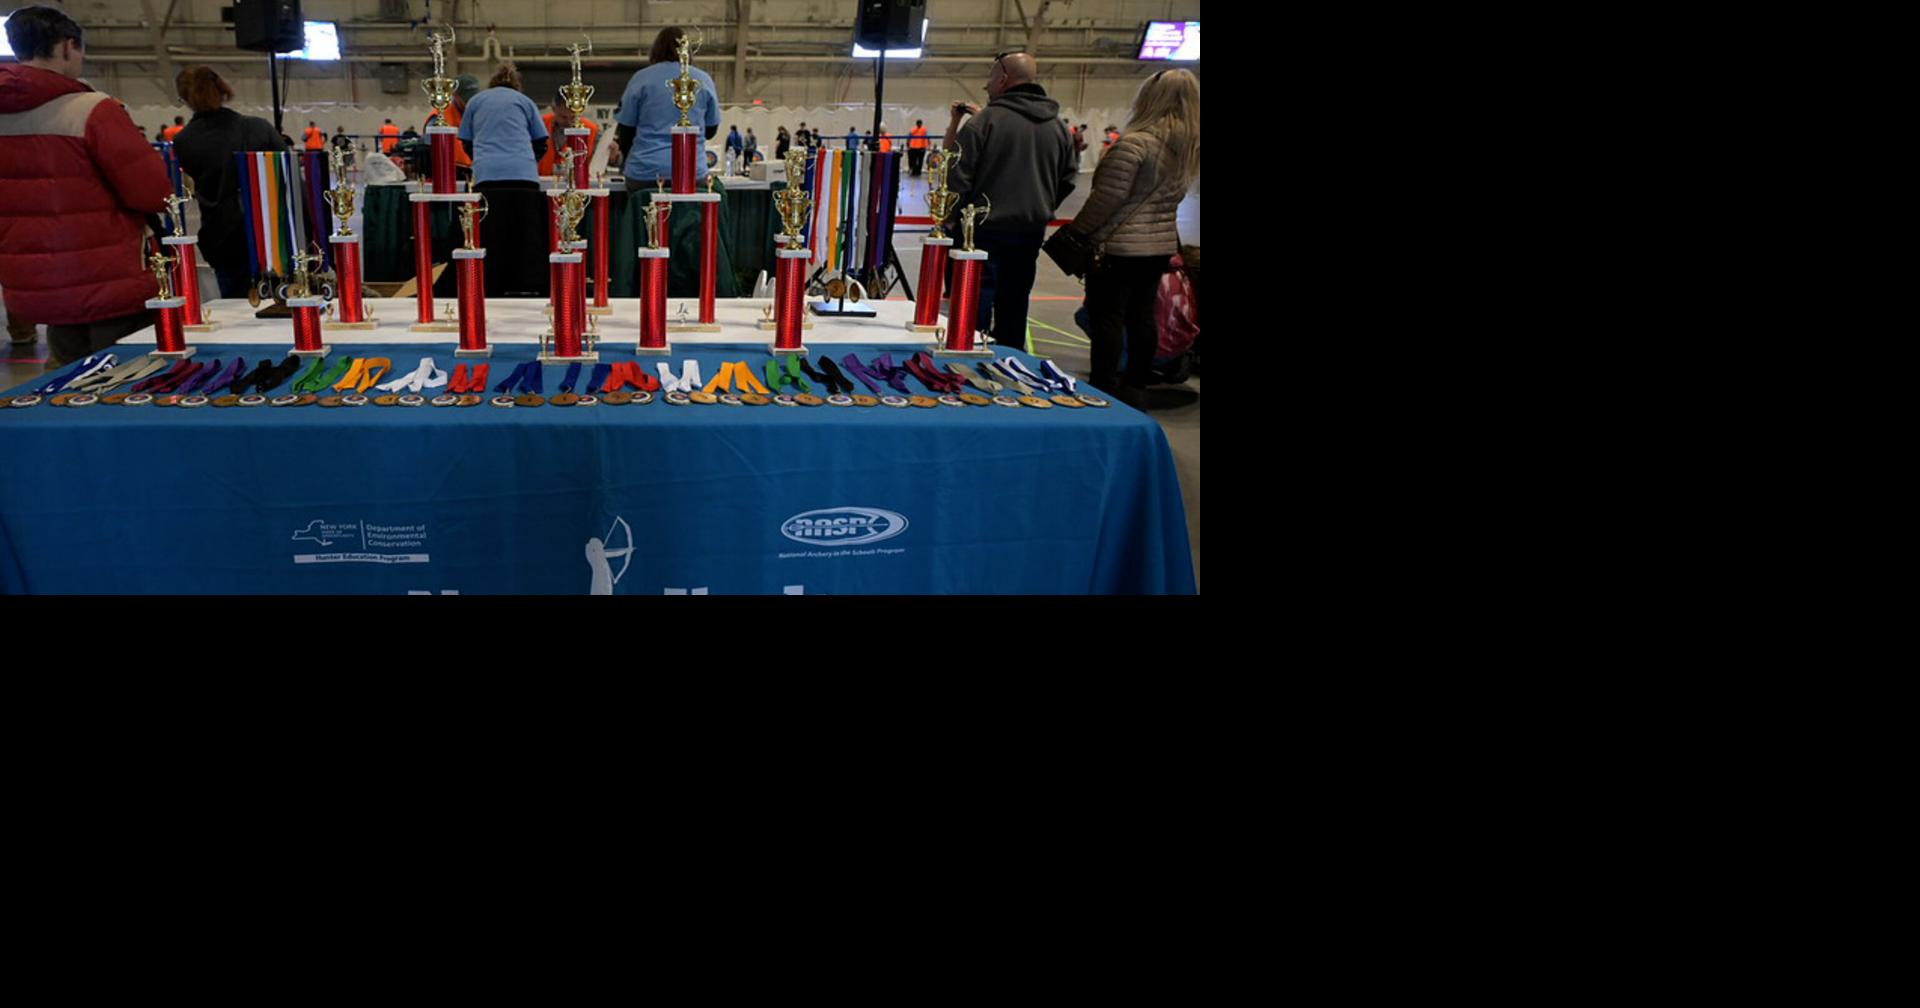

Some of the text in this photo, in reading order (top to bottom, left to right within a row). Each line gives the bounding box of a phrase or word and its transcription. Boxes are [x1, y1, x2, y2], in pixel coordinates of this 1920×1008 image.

[366, 524, 425, 532] Department of
[367, 532, 427, 540] Environmental
[368, 540, 422, 548] Conservation
[315, 553, 411, 563] Hunter Education Program
[778, 551, 807, 559] National
[808, 551, 832, 560] Archery
